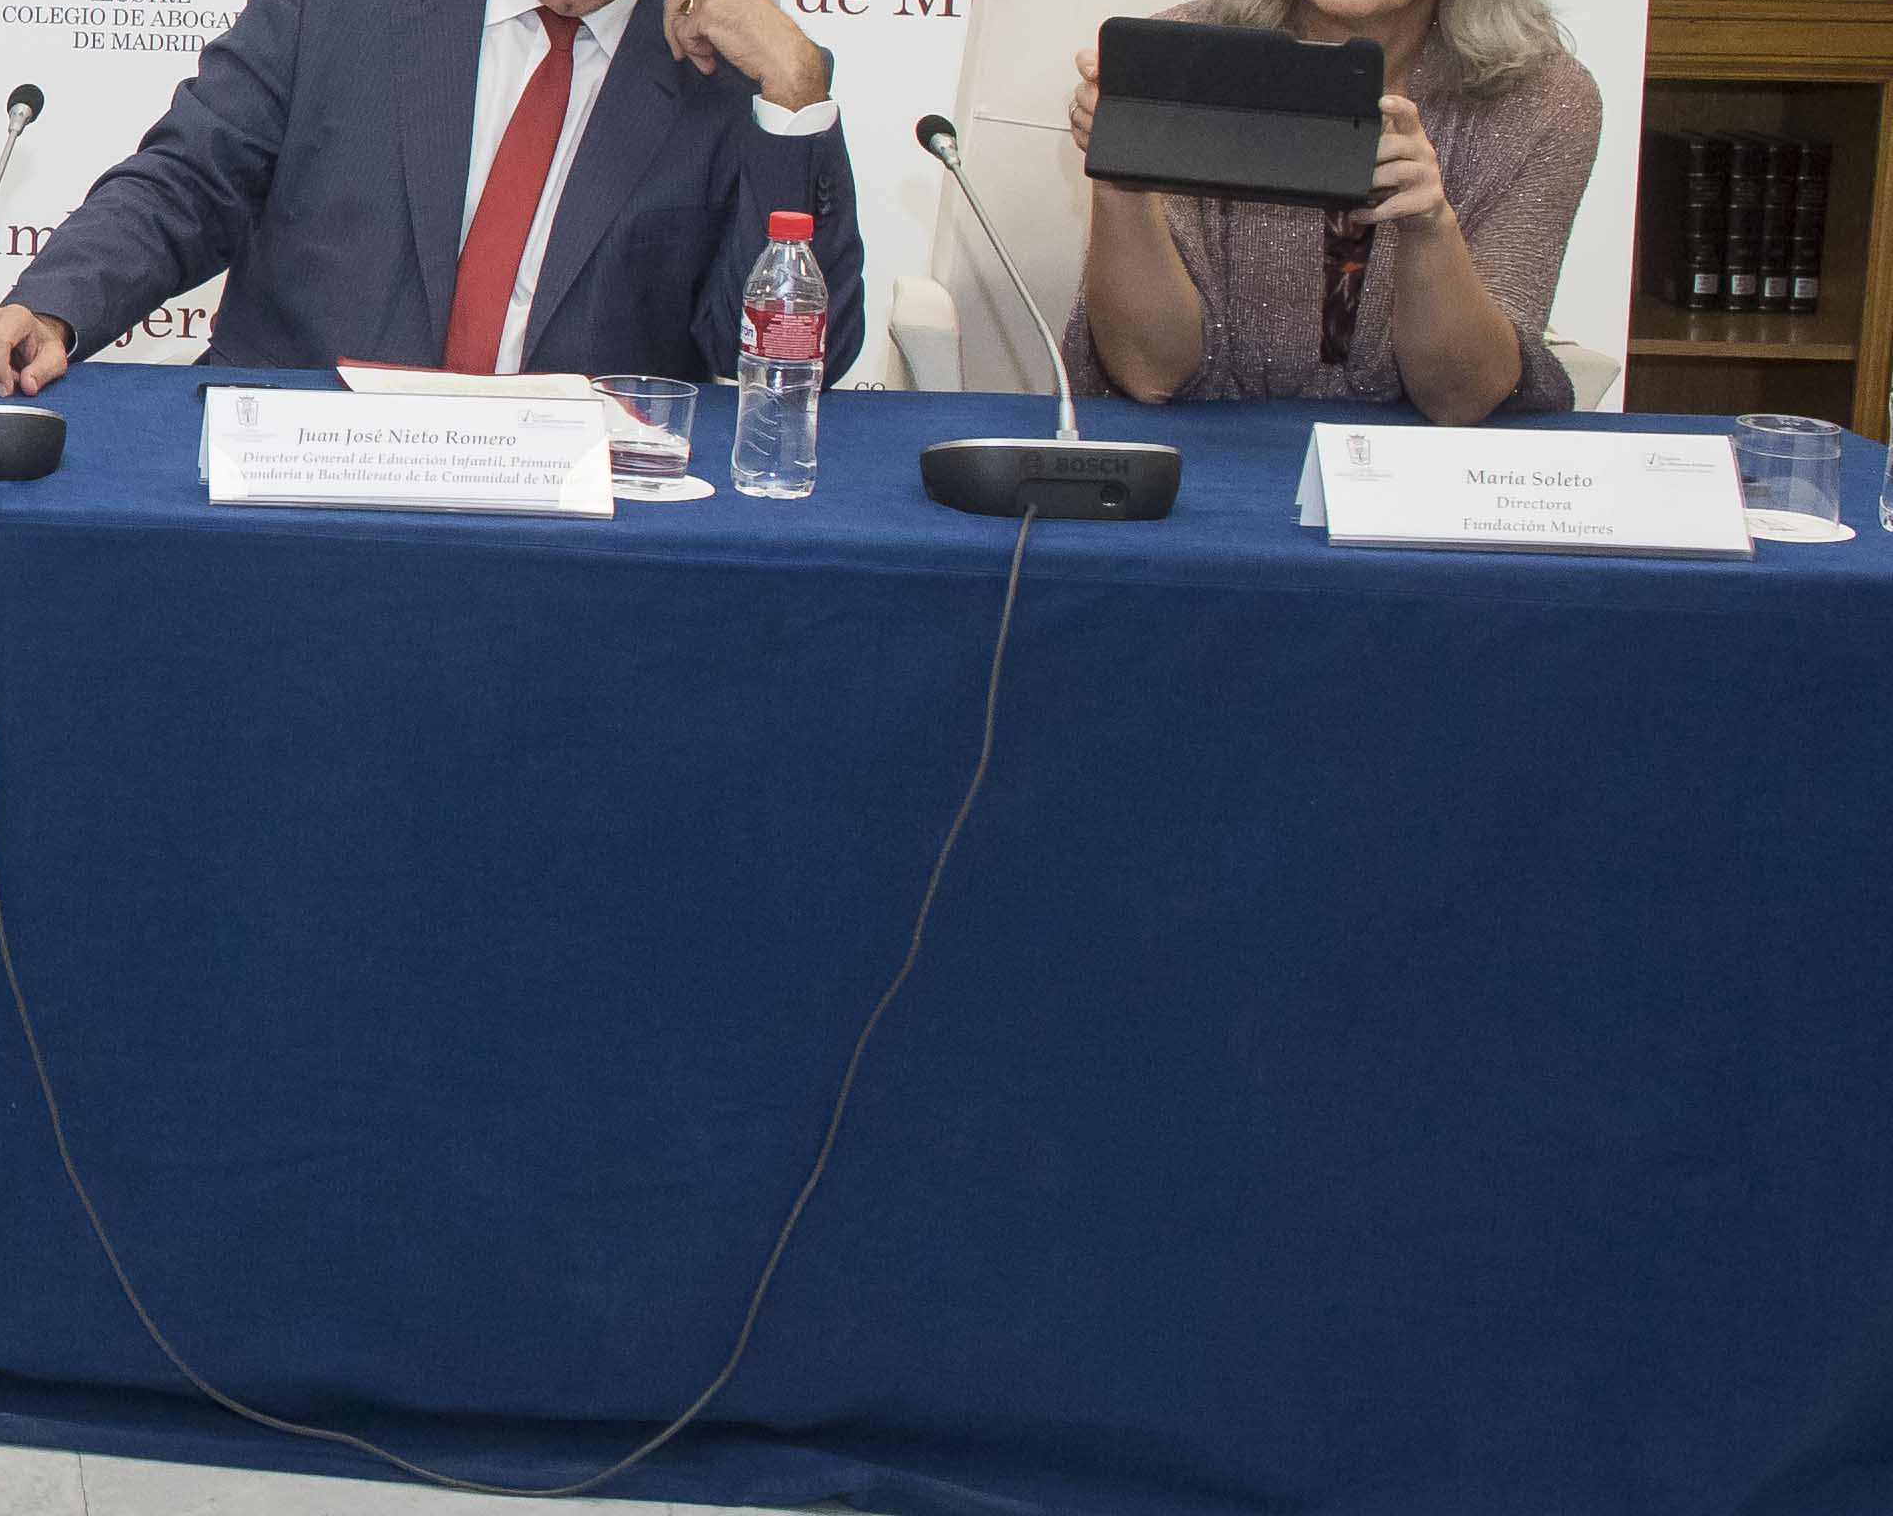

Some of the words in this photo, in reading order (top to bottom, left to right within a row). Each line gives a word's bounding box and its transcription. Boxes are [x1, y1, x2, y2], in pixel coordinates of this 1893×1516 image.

[3, 6, 105, 25] COLEGIO
[114, 9, 144, 26] DE
[150, 10, 241, 29] ABOGA
[74, 32, 104, 49] DE
[111, 33, 205, 52] MADRID
[299, 427, 338, 444] Juan
[346, 429, 382, 445] José
[389, 430, 438, 444] Nieto
[446, 431, 516, 445] Romero
[242, 451, 299, 464] Director
[302, 453, 355, 465] General
[357, 453, 374, 465] de
[378, 454, 445, 467] Educación
[1054, 458, 1130, 474] BOSCH
[318, 469, 402, 483] Bachillerato
[441, 471, 520, 485] Comunidad
[1533, 472, 1592, 487] Soleto
[1497, 496, 1571, 510] Directora
[1463, 517, 1546, 533] Fundación
[1550, 521, 1614, 537] Mujeres
